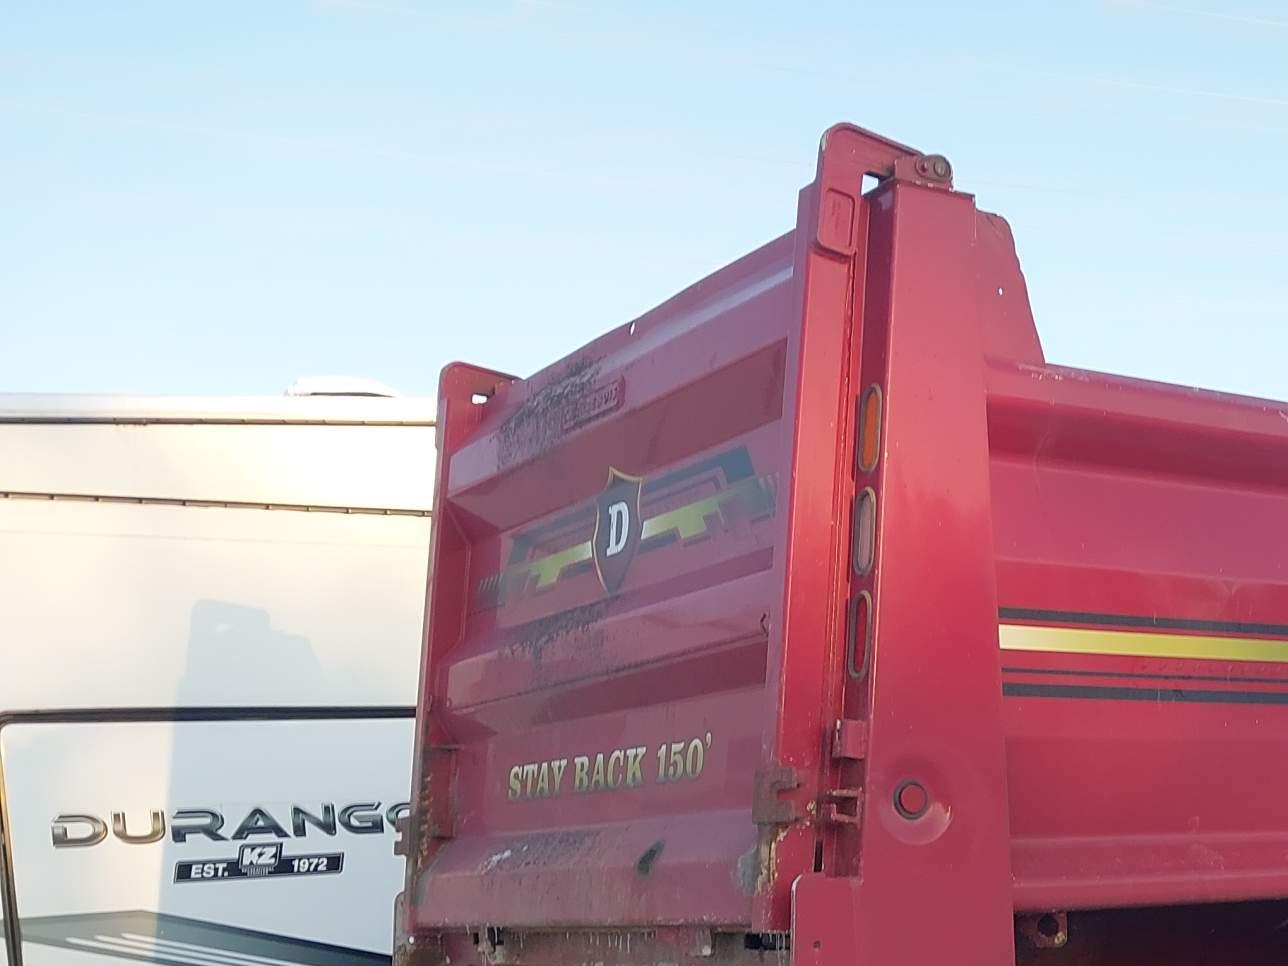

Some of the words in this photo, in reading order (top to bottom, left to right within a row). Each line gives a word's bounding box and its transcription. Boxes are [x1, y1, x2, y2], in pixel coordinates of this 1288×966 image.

[606, 501, 629, 557] D
[508, 759, 568, 801] STAY
[573, 746, 647, 792] BACK
[190, 862, 229, 879] EST.
[242, 846, 277, 866] KZ
[292, 857, 328, 873] 1972
